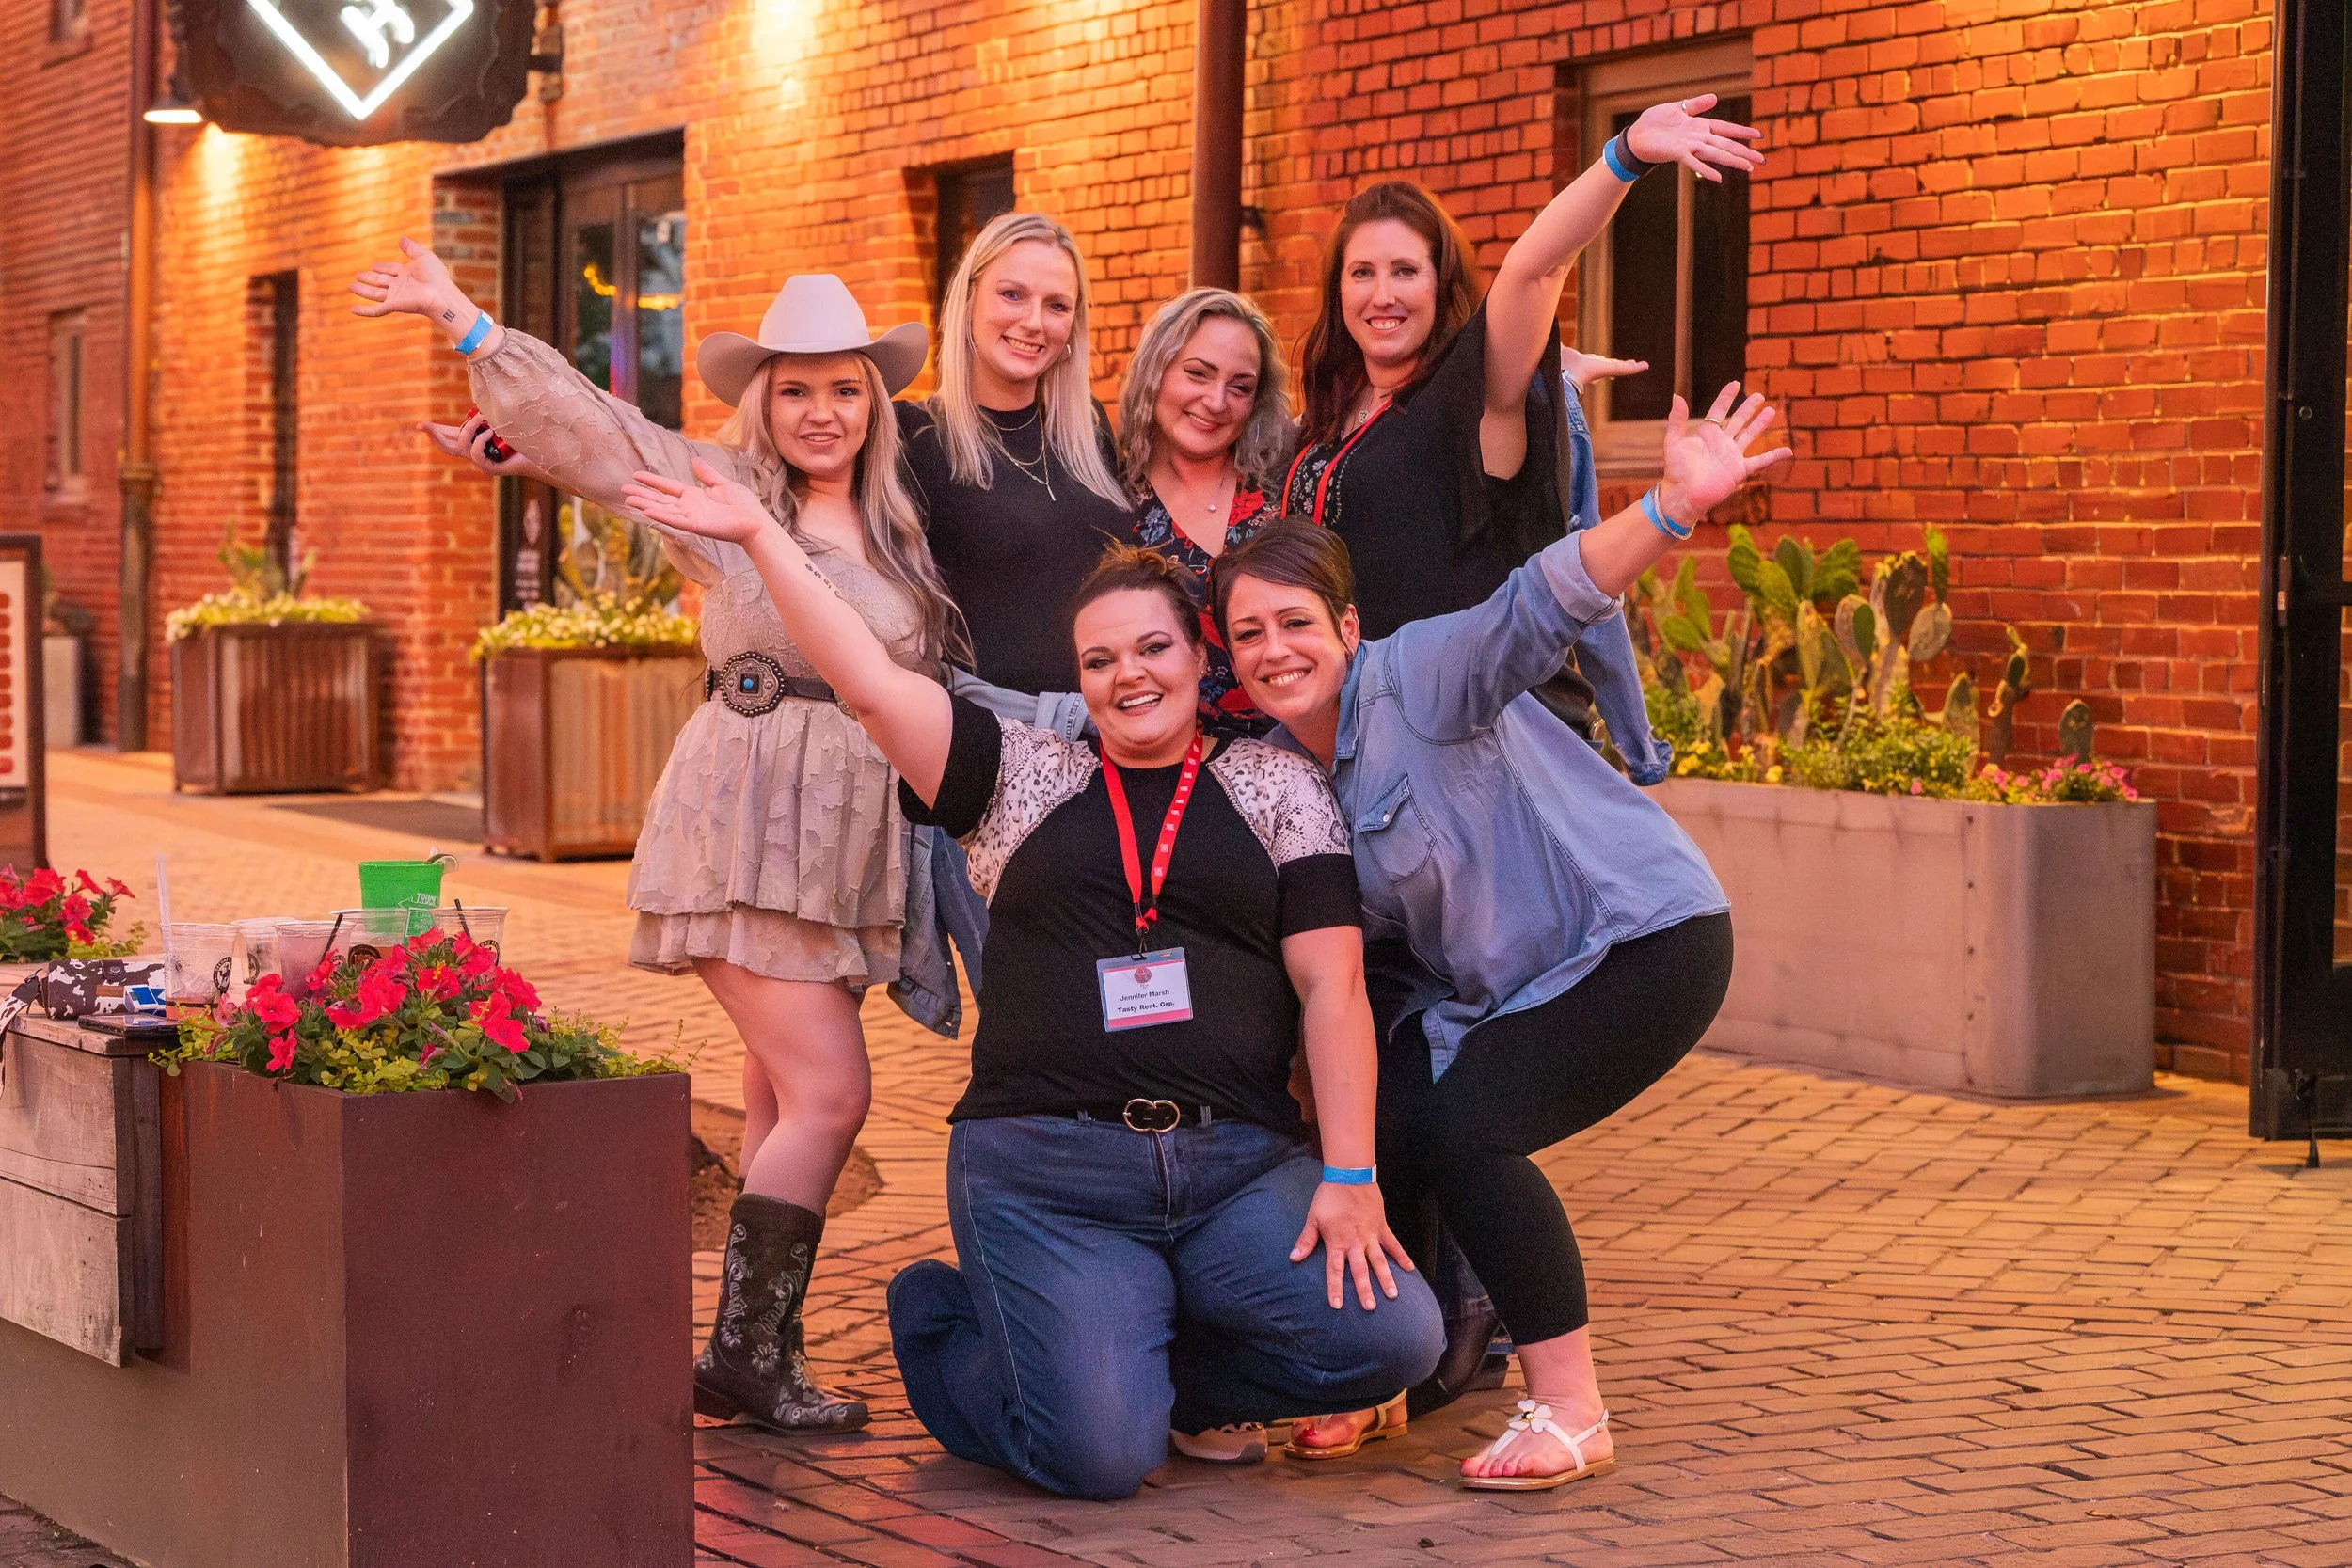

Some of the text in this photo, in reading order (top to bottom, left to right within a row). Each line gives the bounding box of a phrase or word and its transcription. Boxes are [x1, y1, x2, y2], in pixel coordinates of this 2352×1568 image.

[1120, 990, 1170, 1002] Jennifer Marsh
[1159, 1001, 1175, 1009] Grp.
